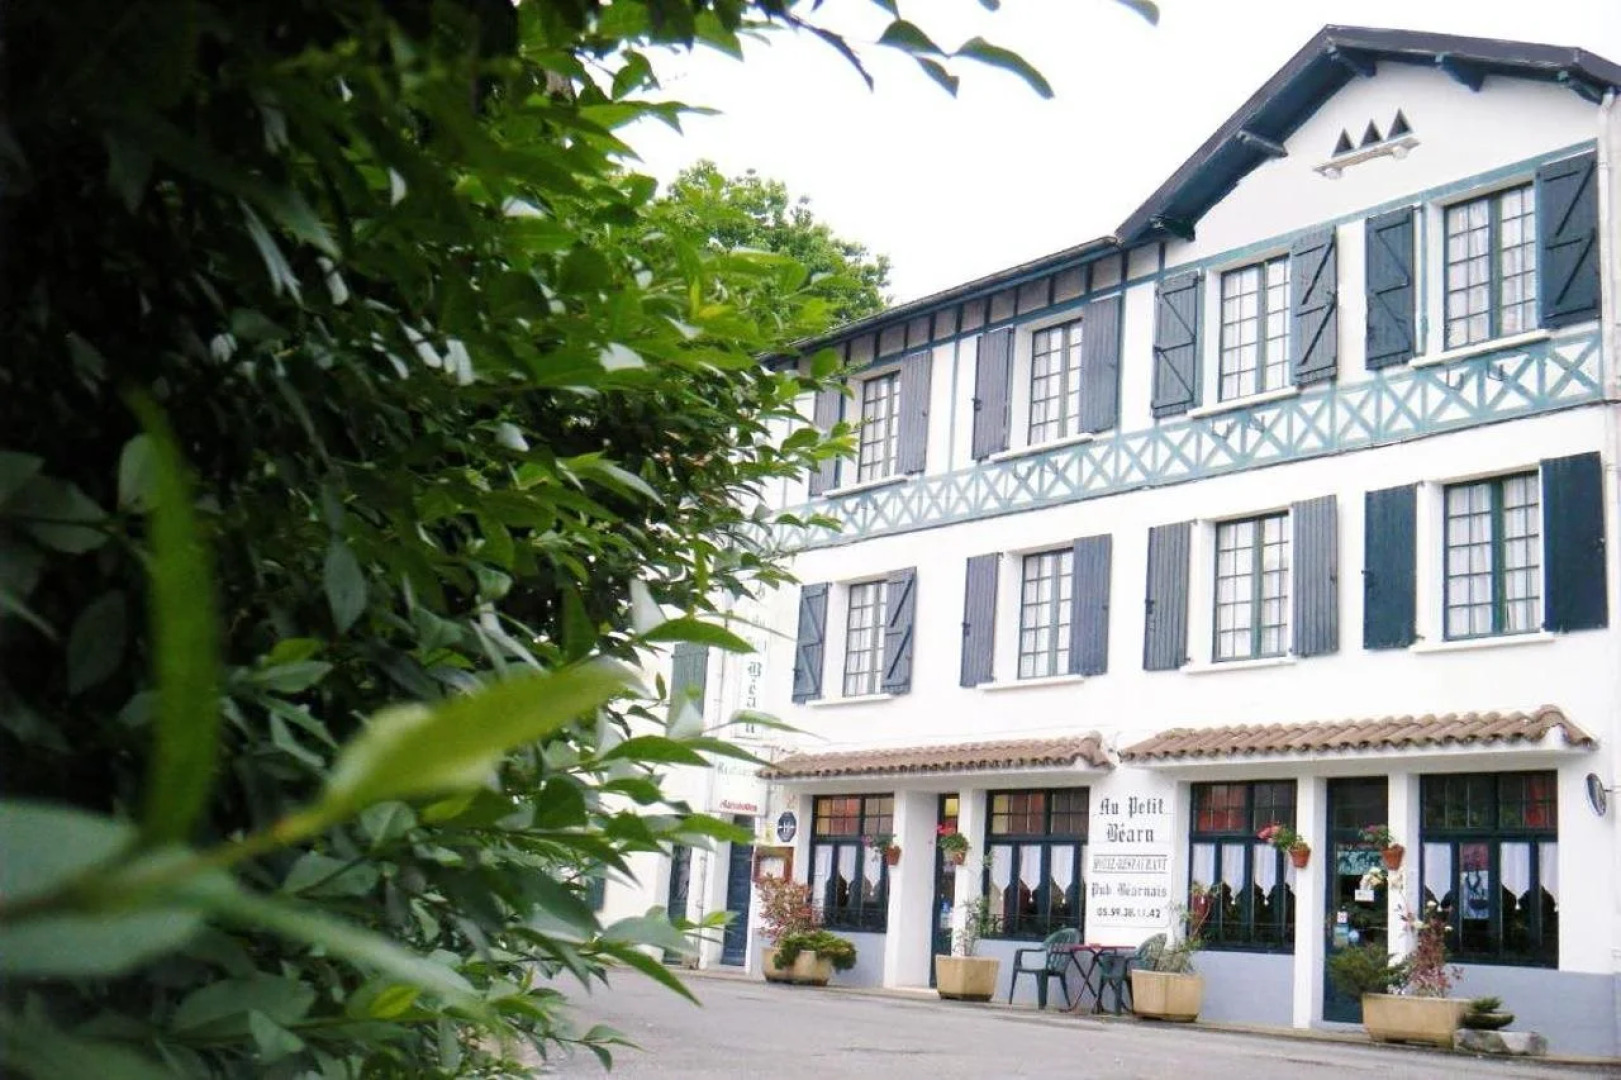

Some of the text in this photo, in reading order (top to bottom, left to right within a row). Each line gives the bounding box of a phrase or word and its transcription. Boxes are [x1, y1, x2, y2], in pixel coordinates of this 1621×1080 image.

[1099, 796, 1163, 818] Au Petit
[1106, 822, 1154, 842] Béarn
